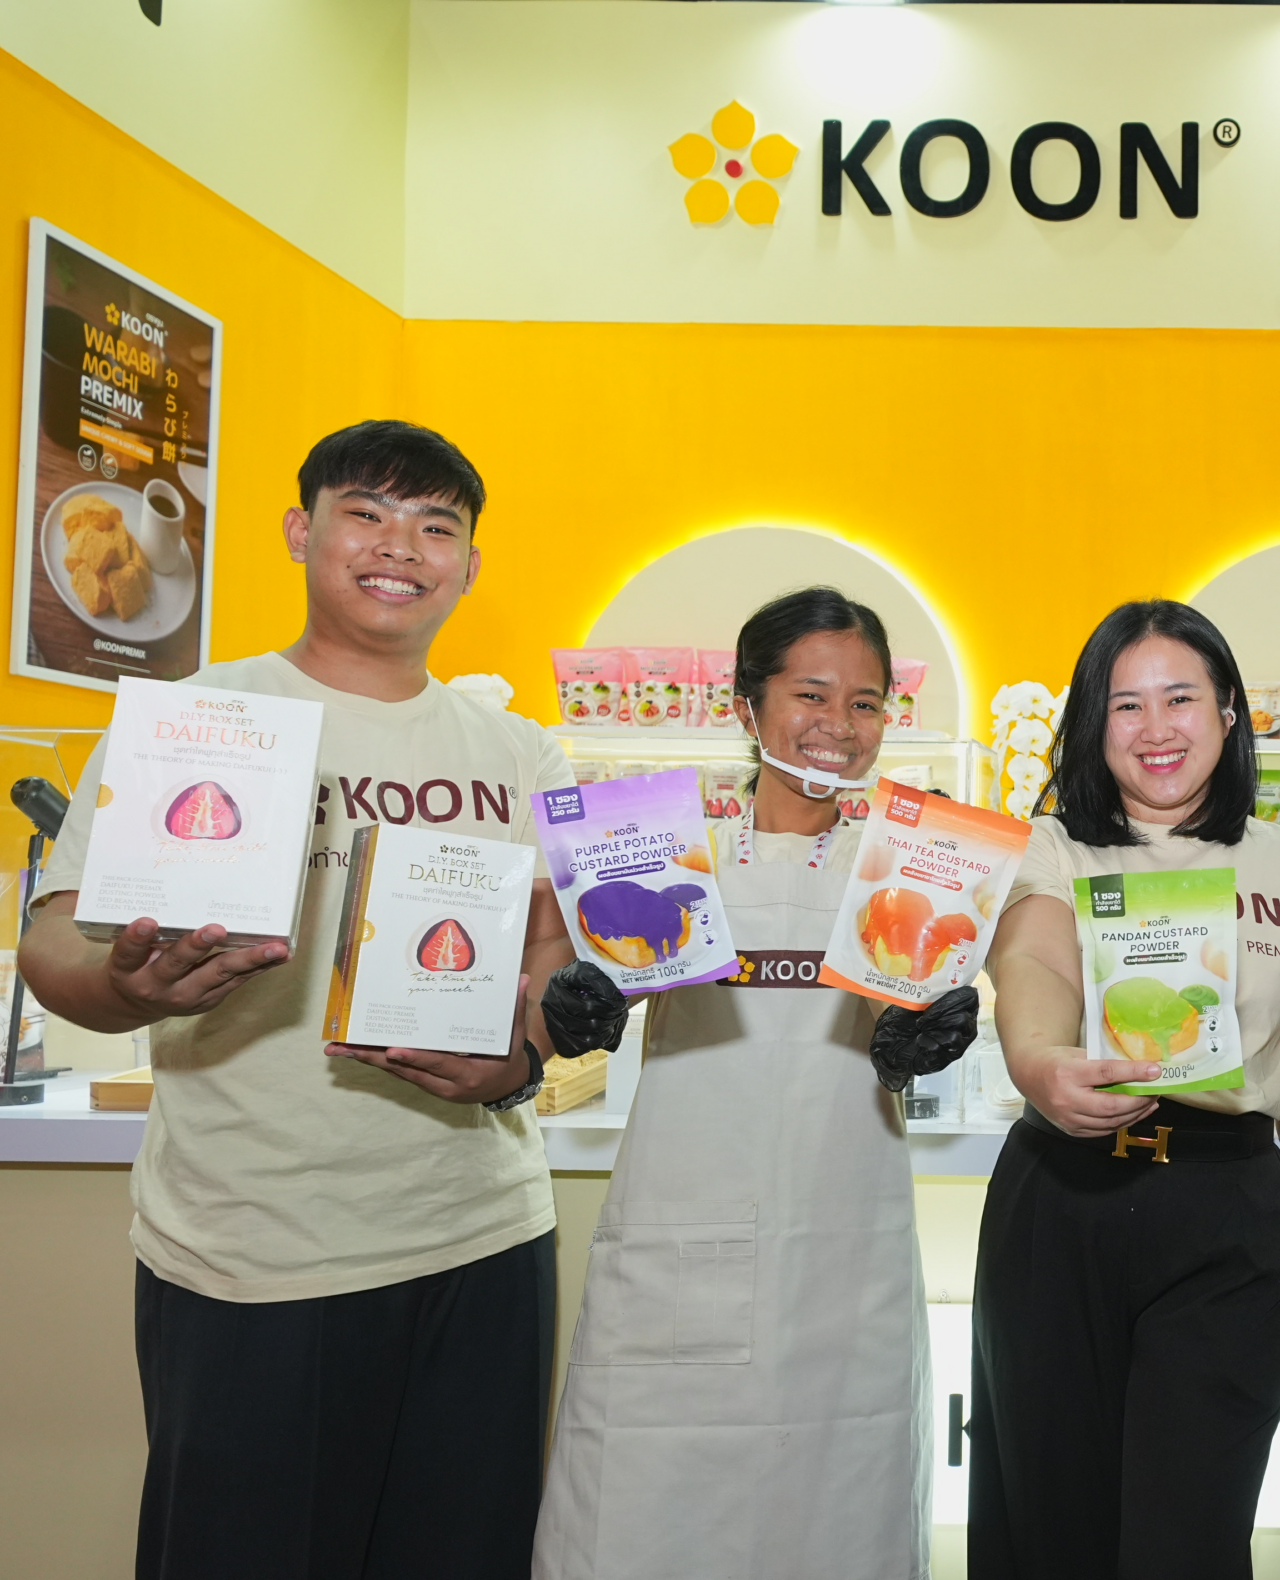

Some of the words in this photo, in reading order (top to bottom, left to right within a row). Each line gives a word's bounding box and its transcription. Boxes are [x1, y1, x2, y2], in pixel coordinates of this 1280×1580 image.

[83, 323, 156, 379] WARABI
[82, 352, 138, 394] MOCHI
[80, 375, 144, 420] PREMIX
[162, 367, 178, 463] わらび餅
[93, 639, 146, 659] @KOONPREMIX
[209, 714, 232, 726] BOX
[234, 717, 255, 727] SET
[154, 721, 277, 750] DAIFUKU
[133, 752, 149, 761] THE
[151, 754, 184, 764] THEORY
[185, 757, 196, 765] OF
[198, 759, 232, 769] MAKING
[547, 796, 553, 805] 1
[893, 795, 899, 803] 1
[891, 809, 904, 817] 500
[449, 846, 478, 858] KOON
[575, 840, 622, 858] PURPLE
[624, 832, 675, 850] POTATO
[569, 853, 630, 873] CUSTARD
[633, 844, 687, 863] POWDER
[887, 835, 913, 851] THAI
[915, 844, 934, 858] TEA
[937, 851, 991, 875] CUSTARD
[450, 858, 468, 869] BOX
[470, 861, 486, 871] SET
[909, 856, 960, 878] POWDER
[407, 863, 502, 892] DAIFUKU
[391, 891, 405, 899] THE
[405, 893, 431, 903] THEORY
[432, 896, 441, 904] OF
[442, 898, 469, 908] MAKING
[1093, 892, 1099, 901] 1
[1101, 930, 1151, 942] PANDAN
[1153, 926, 1209, 940] CUSTARD
[1130, 940, 1180, 953] POWDER
[657, 965, 678, 978] 100
[677, 960, 692, 969] กรัม
[760, 960, 823, 981] KOO
[634, 974, 657, 983] WEIGHT
[864, 977, 875, 985] NET
[875, 979, 897, 991] WEIGHT
[898, 981, 917, 997] 200
[918, 984, 931, 995] กรัม
[916, 991, 922, 999] g
[1162, 1066, 1181, 1079] 200
[1181, 1071, 1187, 1079] g
